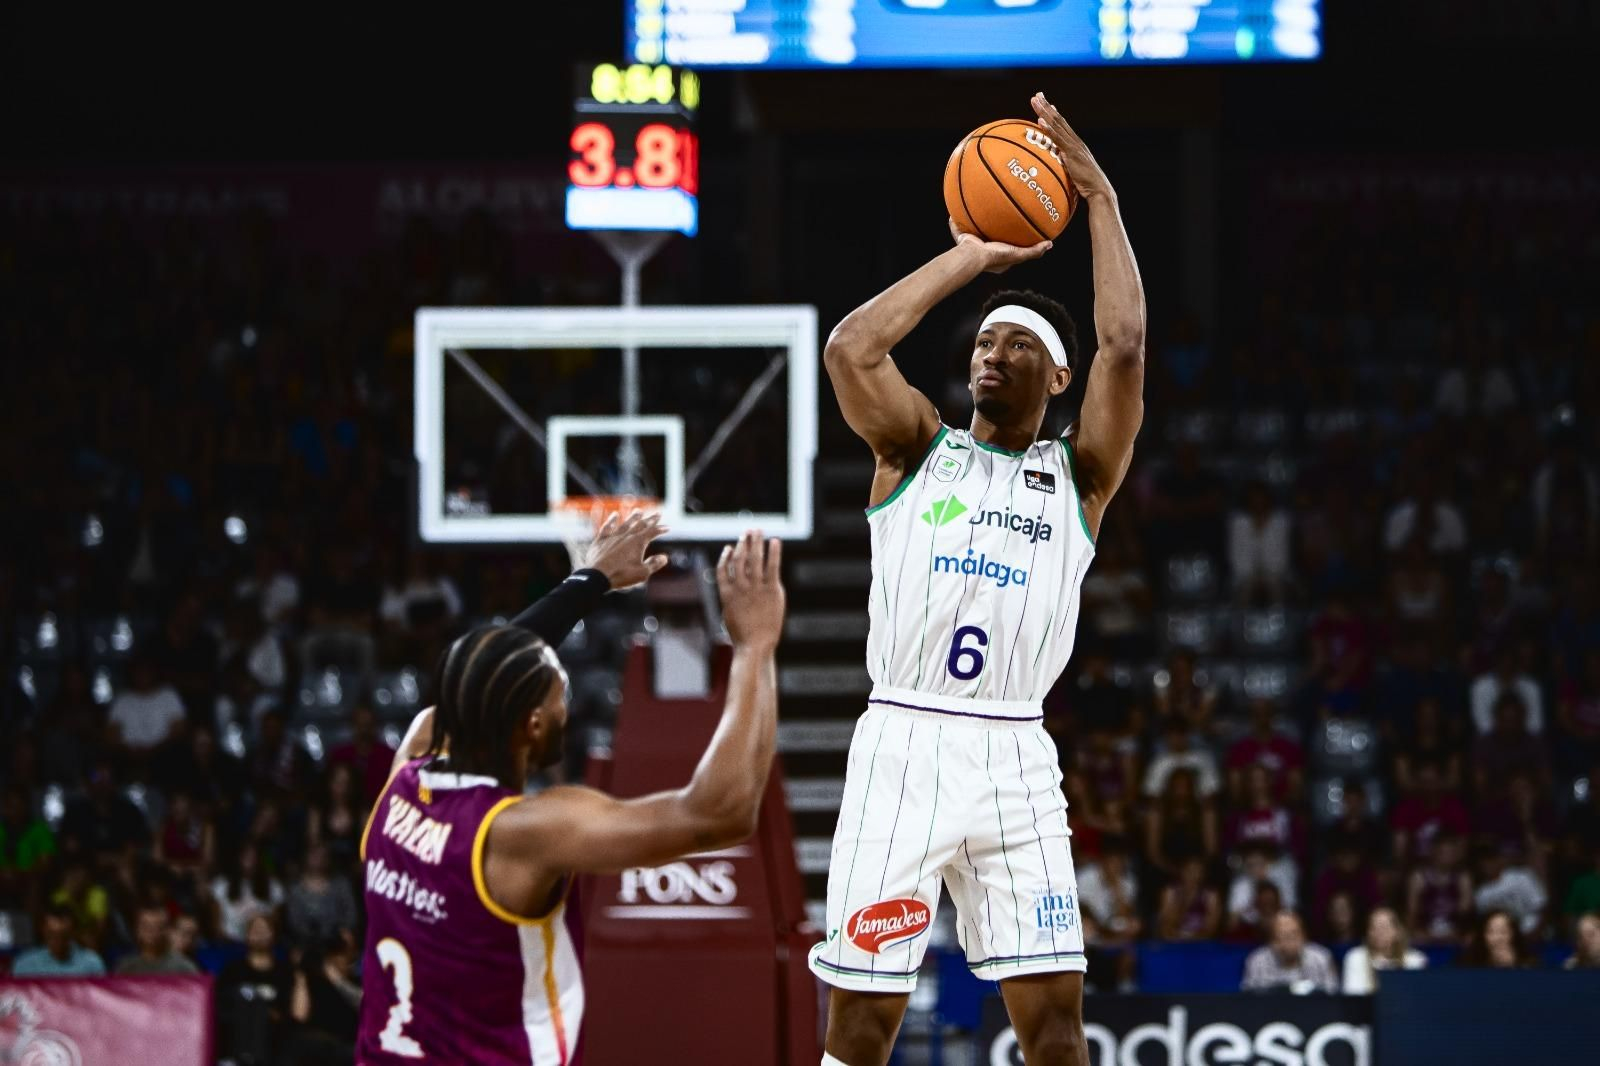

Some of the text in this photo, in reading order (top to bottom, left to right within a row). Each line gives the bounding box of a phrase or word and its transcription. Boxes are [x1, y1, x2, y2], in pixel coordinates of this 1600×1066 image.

[1007, 158, 1029, 182] liga
[1028, 180, 1061, 222] endesa
[968, 506, 1052, 544] unicaja
[947, 625, 988, 681] 6
[615, 861, 738, 905] PONS
[849, 903, 927, 942] famadesa
[376, 937, 425, 1059] 2
